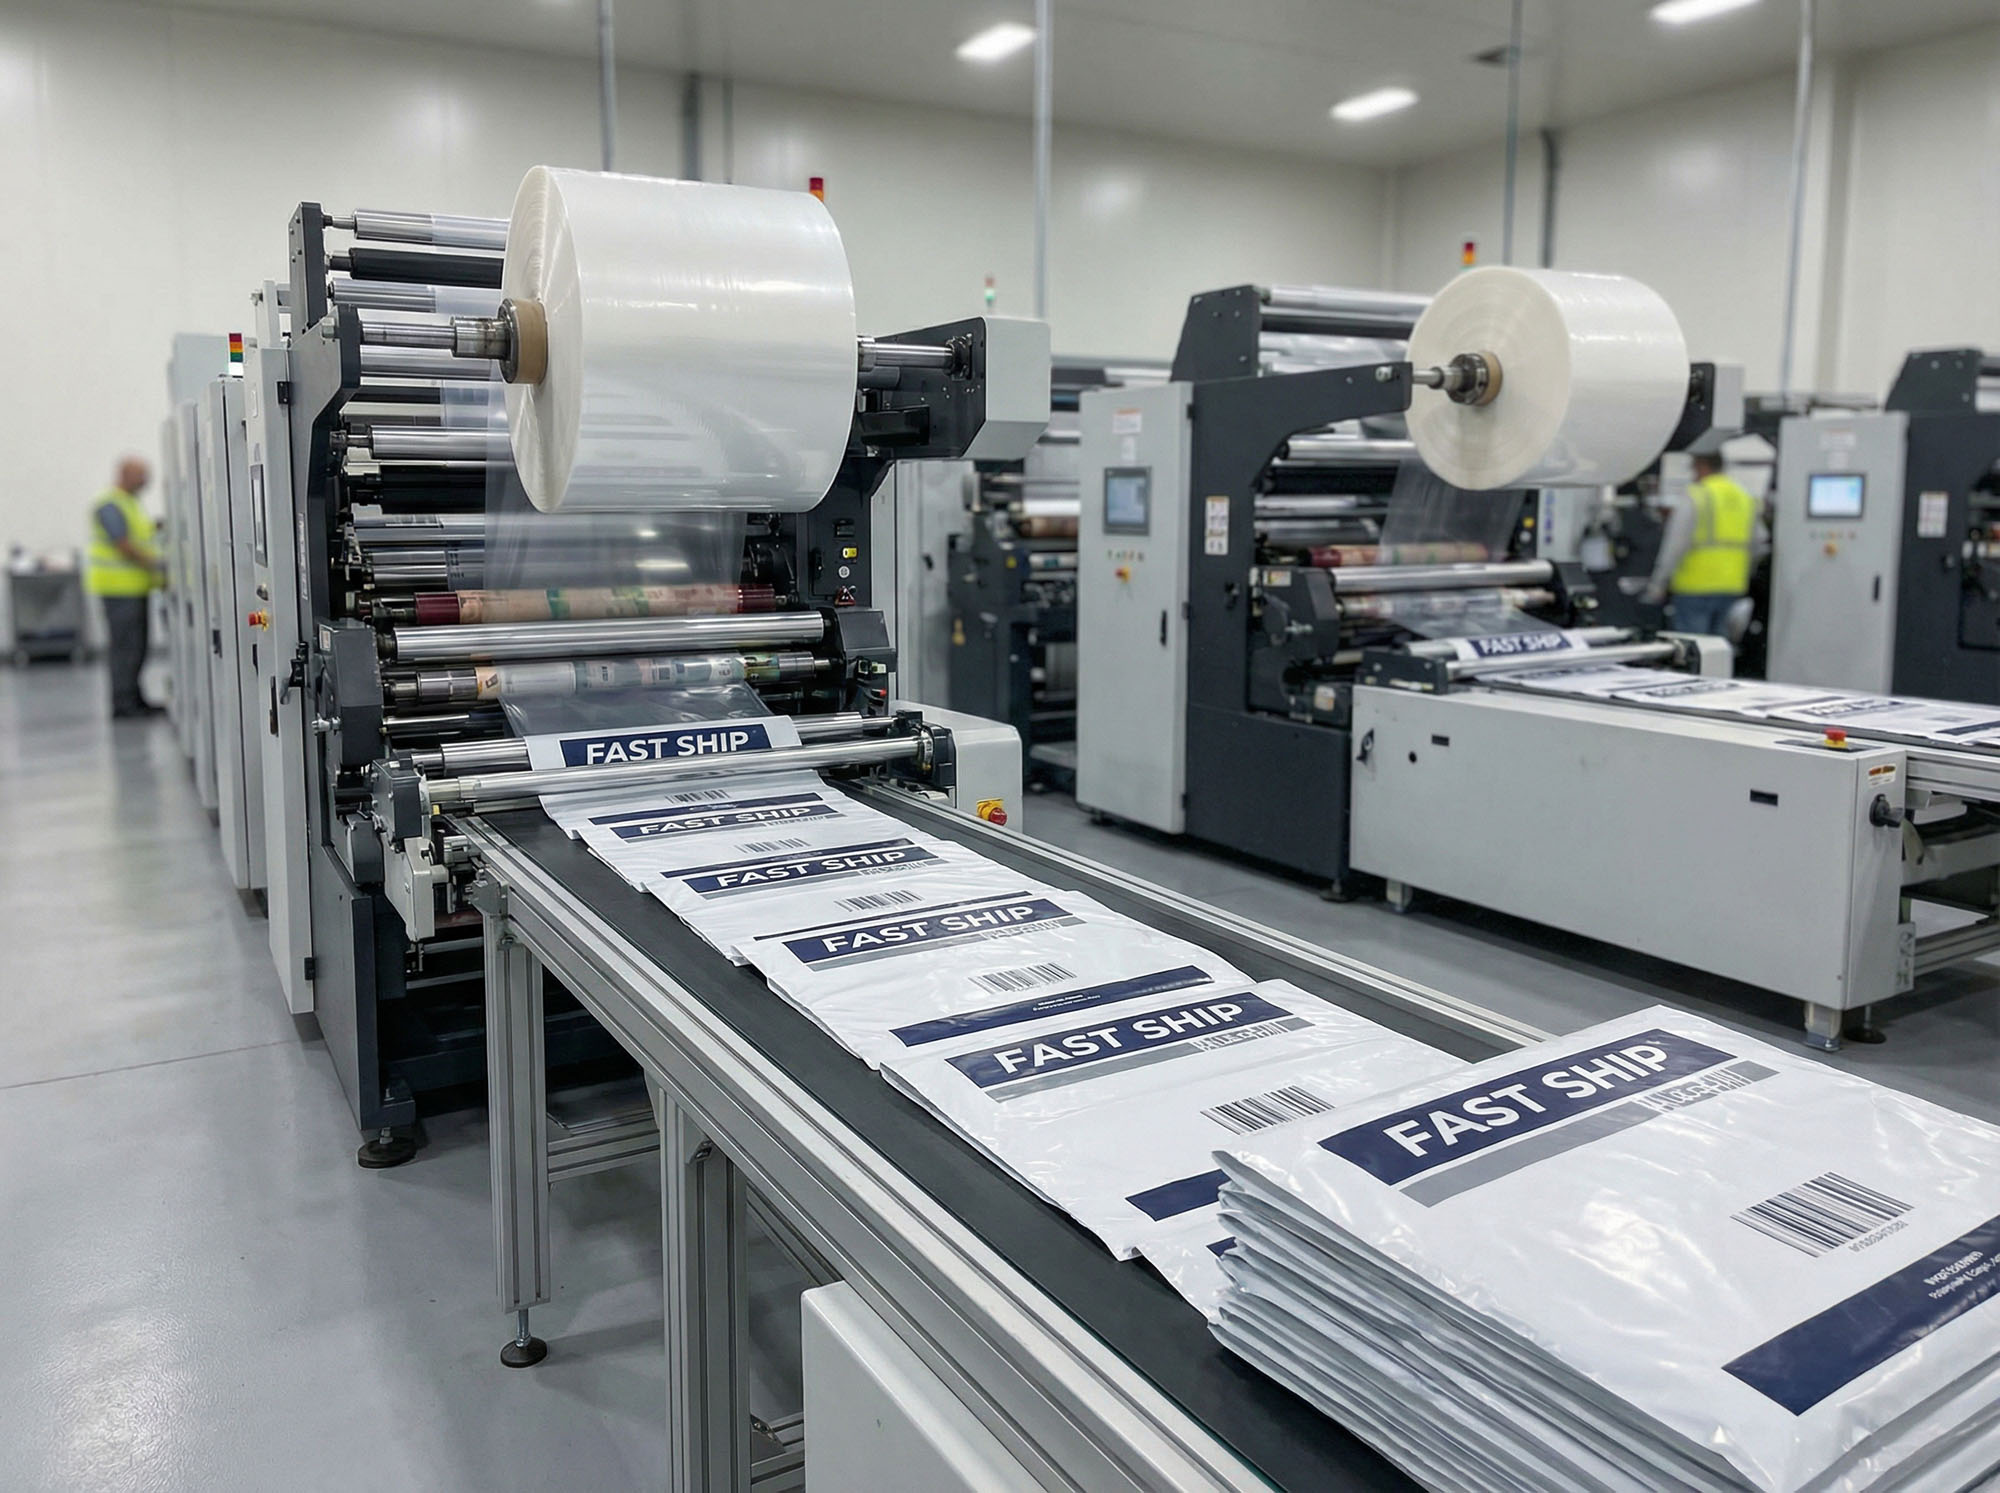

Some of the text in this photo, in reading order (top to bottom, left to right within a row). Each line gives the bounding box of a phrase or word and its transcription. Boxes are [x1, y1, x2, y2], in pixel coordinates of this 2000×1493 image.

[587, 731, 748, 764] FAST SHIP
[640, 815, 724, 835] FAST
[735, 806, 811, 822] SHIP
[717, 863, 810, 887] FAST
[820, 851, 905, 870] SHIP
[821, 922, 929, 953] FAST
[940, 906, 1033, 931] SHIP
[993, 1027, 1123, 1074] FAST
[1131, 1002, 1244, 1040] SHIP
[1382, 1083, 1546, 1158] FAST
[1542, 1044, 1668, 1099] SHIP
